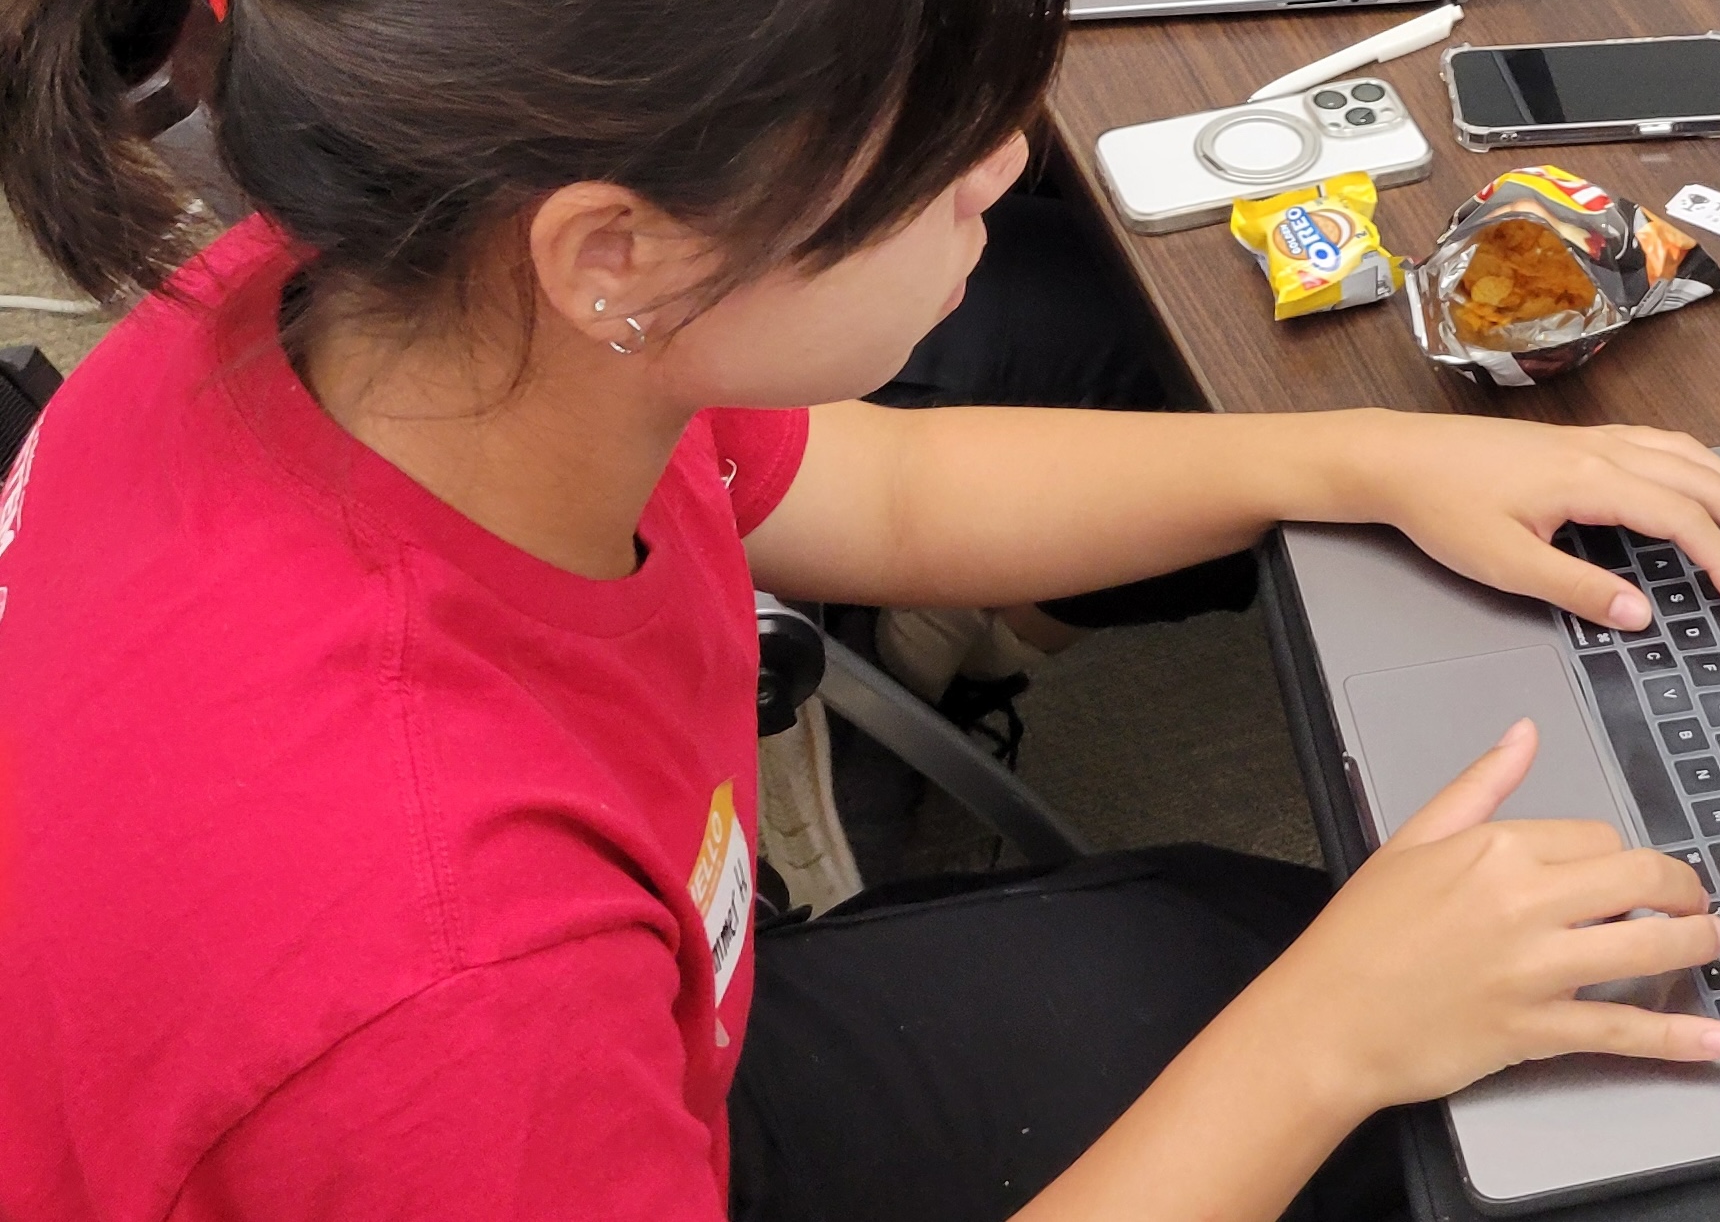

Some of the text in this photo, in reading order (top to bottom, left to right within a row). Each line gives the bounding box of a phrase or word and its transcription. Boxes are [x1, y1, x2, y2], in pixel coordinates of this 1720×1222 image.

[1286, 206, 1340, 271] OREO
[1655, 560, 1668, 569] A
[1670, 593, 1684, 603] S
[1685, 627, 1700, 637] D
[1646, 652, 1661, 660] C
[1702, 664, 1718, 672] F
[1663, 688, 1678, 698] V
[1678, 730, 1693, 740] B
[1695, 769, 1711, 780] N
